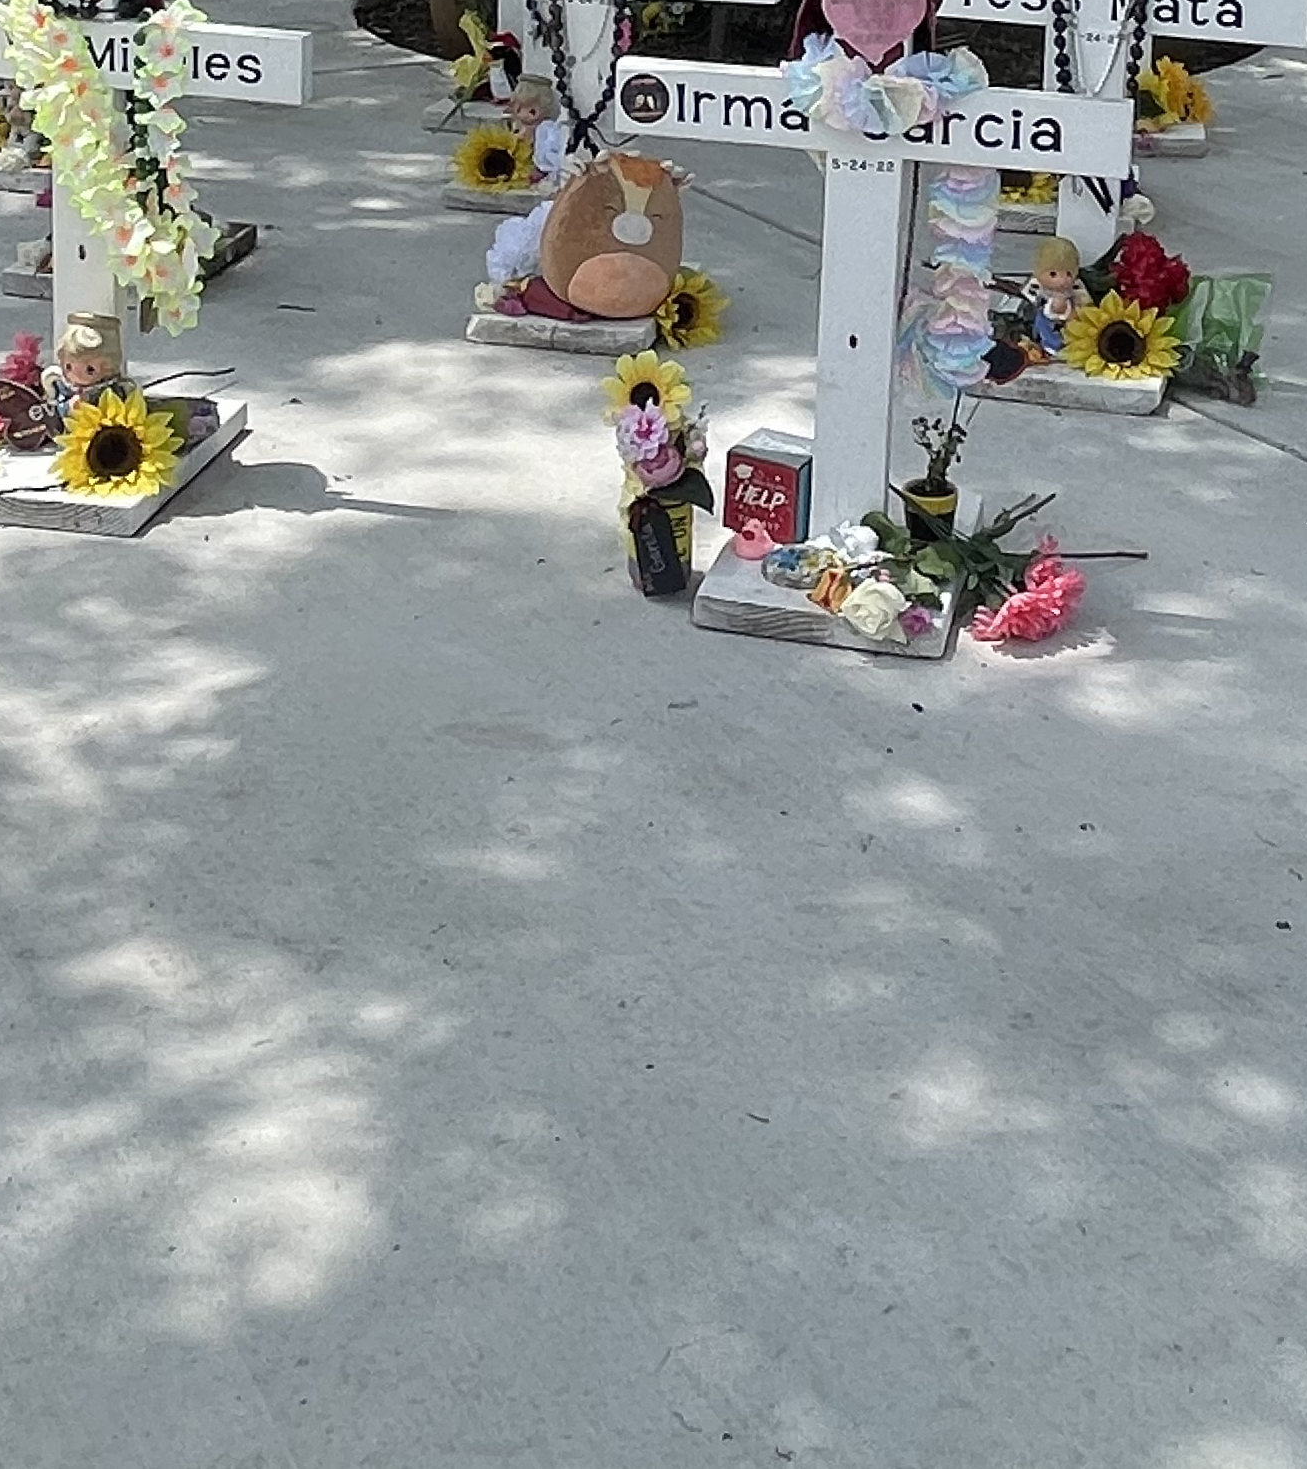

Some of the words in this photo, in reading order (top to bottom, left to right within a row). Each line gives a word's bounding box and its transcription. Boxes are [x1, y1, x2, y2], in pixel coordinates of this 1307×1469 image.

[84, 34, 263, 84] Miles
[862, 108, 1063, 153] arcia
[831, 158, 896, 172] 5-24-22
[734, 483, 787, 511] HELP
